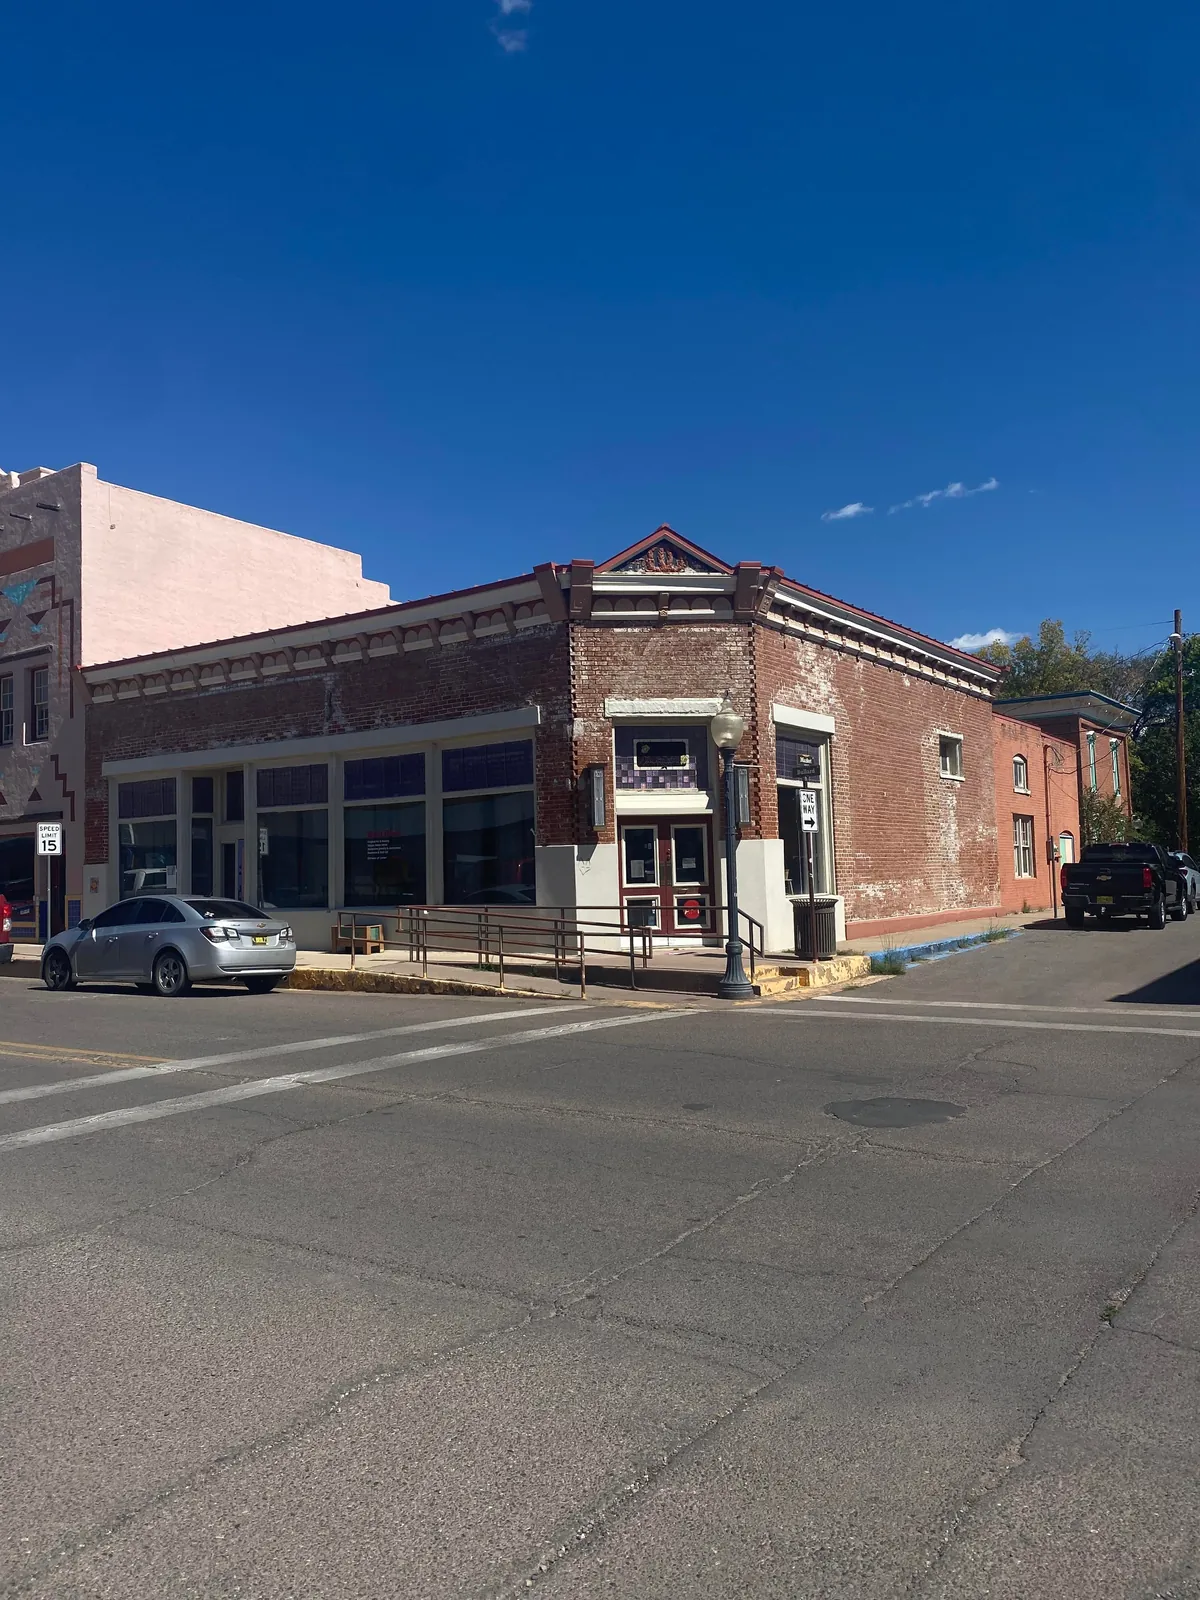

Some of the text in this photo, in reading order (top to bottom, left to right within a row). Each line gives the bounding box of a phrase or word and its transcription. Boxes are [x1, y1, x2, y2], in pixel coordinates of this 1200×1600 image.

[802, 794, 814, 803] ONE
[802, 804, 814, 814] WAY
[42, 840, 57, 851] 15
